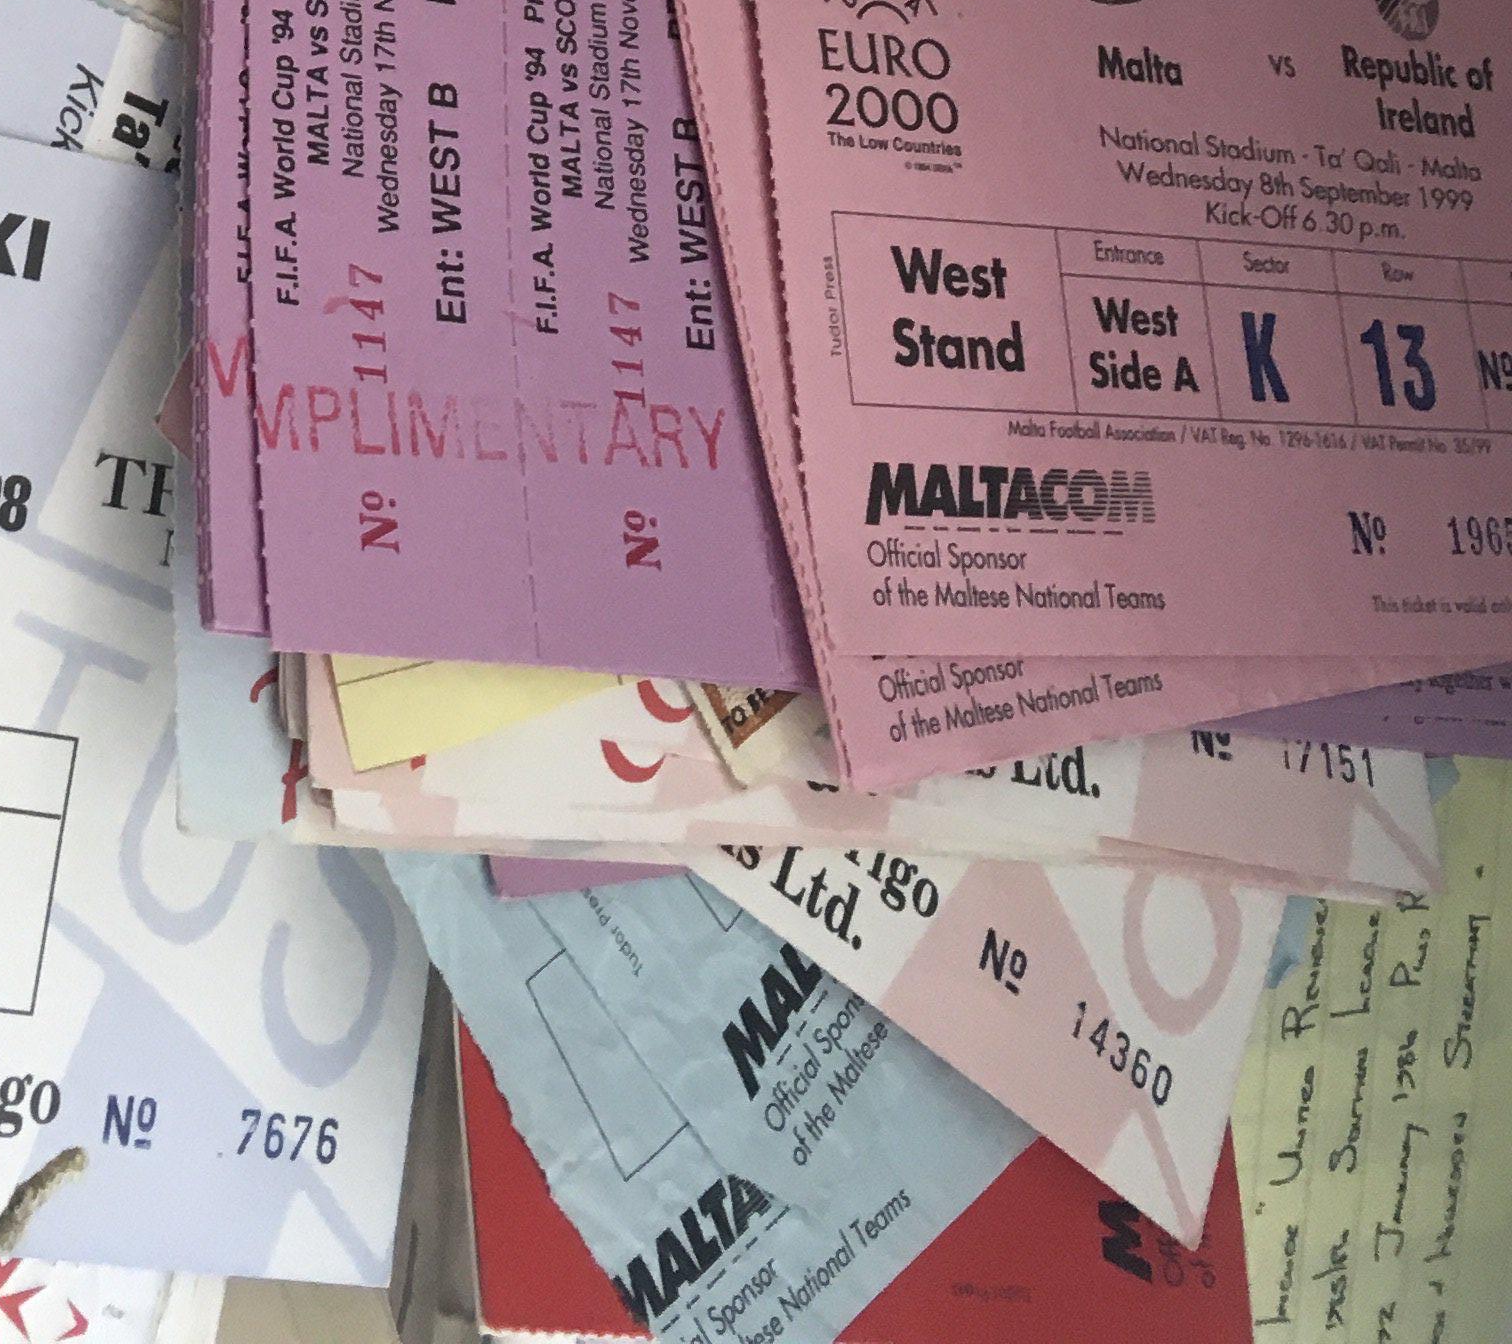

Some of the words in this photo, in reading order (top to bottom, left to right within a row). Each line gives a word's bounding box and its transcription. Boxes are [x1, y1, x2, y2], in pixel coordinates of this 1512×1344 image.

[307, 28, 329, 60] vs
[816, 26, 953, 81] EURO
[1096, 44, 1184, 88] Malta
[1267, 52, 1298, 79] vs
[1340, 44, 1459, 91] Republic
[1464, 55, 1495, 92] of
[305, 65, 331, 166] MALTA
[427, 80, 460, 109] B
[824, 83, 960, 136] 2000
[1375, 97, 1477, 139] Ireland
[427, 119, 462, 236] WEST
[890, 243, 1008, 301] West
[349, 262, 389, 384] 1147
[891, 316, 1027, 374] Stand
[1091, 294, 1180, 339] West
[1088, 349, 1163, 392] Side
[1171, 355, 1201, 393] A
[1240, 310, 1291, 405] K
[1357, 318, 1437, 412] 13
[865, 461, 1158, 526] MALTACOM
[866, 539, 942, 569] Official
[945, 545, 1029, 575] Sponsor
[770, 845, 863, 951] Ltd.
[1070, 1000, 1174, 1107] 14360
[236, 1107, 343, 1170] 7676
